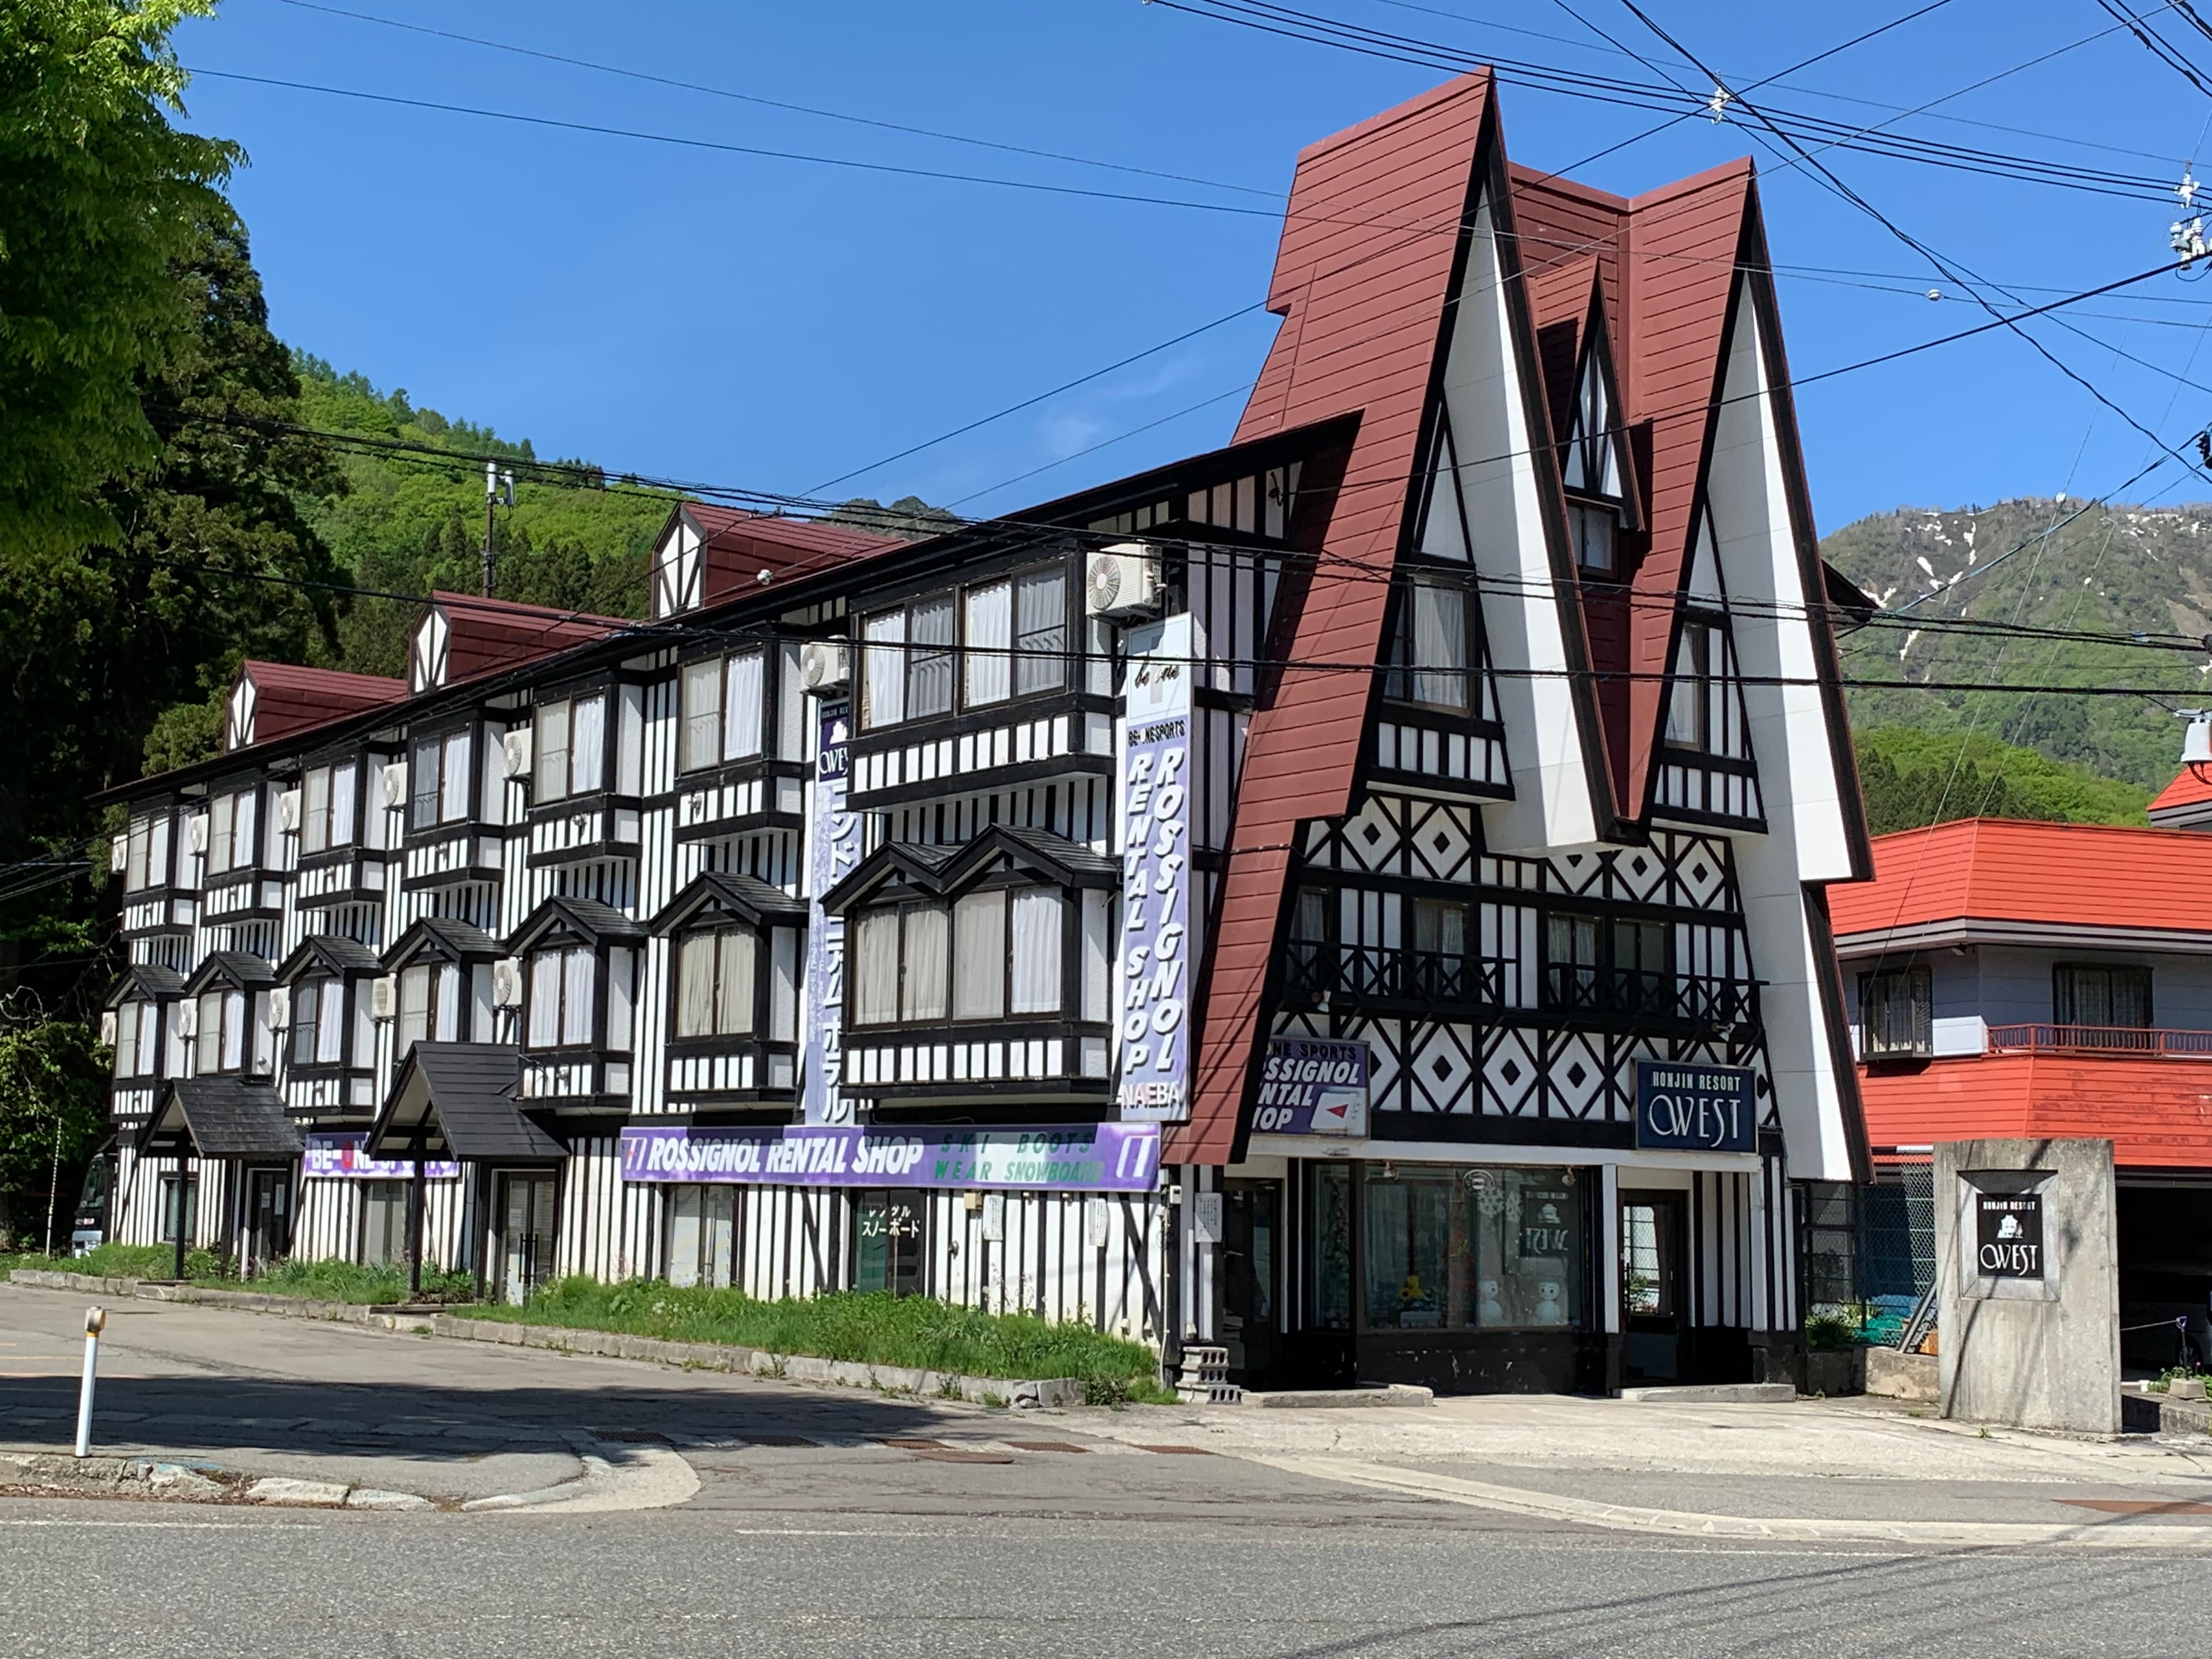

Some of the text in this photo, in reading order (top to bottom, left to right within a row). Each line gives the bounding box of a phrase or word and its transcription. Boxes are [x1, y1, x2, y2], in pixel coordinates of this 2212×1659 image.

[1123, 752, 1154, 1075] RENTAL SHOP
[1151, 747, 1185, 1072] ROSSIGNOL
[1300, 1044, 1356, 1060] SPORTS
[1653, 1071, 1741, 1092] HONJIN RESORT
[1120, 1082, 1183, 1109] NAEBA
[941, 1131, 1094, 1154] SKI BOOTS
[646, 1135, 925, 1175] ROSSIGNOL RENTAL SHOP
[934, 1161, 1104, 1183] WEAR SNOWBOARD
[862, 1217, 921, 1238] スノーボード
